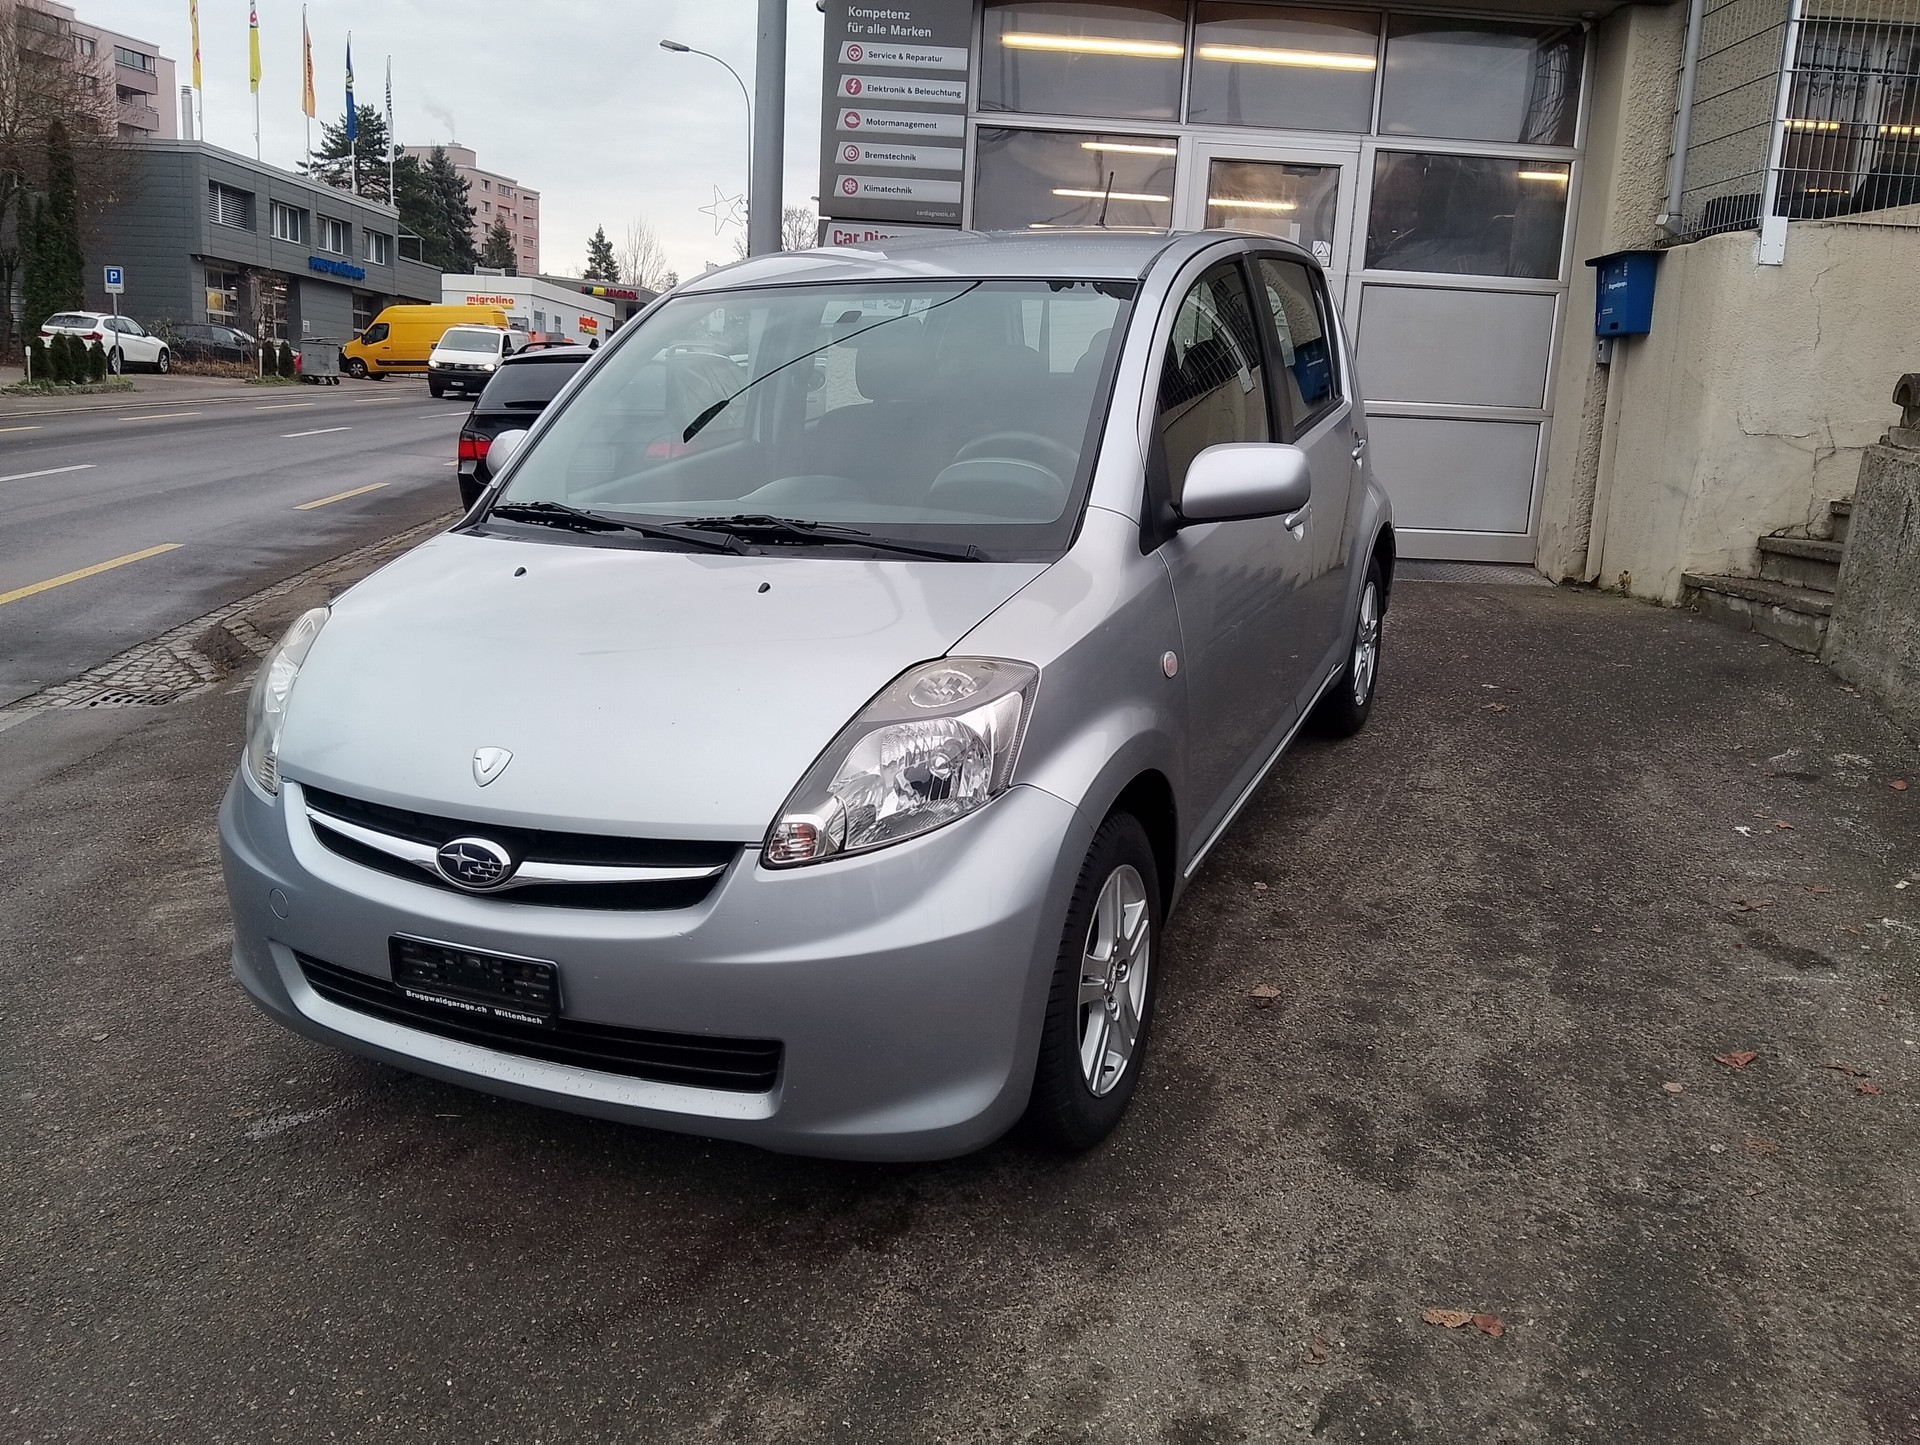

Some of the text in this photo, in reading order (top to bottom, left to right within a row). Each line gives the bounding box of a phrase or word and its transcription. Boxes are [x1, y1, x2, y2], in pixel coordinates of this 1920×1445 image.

[848, 5, 911, 20] Kompetenz
[847, 21, 932, 38] für alle Marken
[868, 50, 943, 63] Service & Reparatur
[867, 84, 962, 99] Elektronik & Beleuchtung
[866, 118, 938, 130] Motormanagement
[864, 151, 917, 162] Bremstechnik
[863, 184, 913, 195] Klimatechnik
[833, 230, 860, 245] Car
[110, 271, 118, 282] P
[466, 294, 514, 305] migrolino
[606, 288, 638, 300] MIGROL
[405, 989, 543, 1025] Bruggwaldgarage.ch Wittenbach
